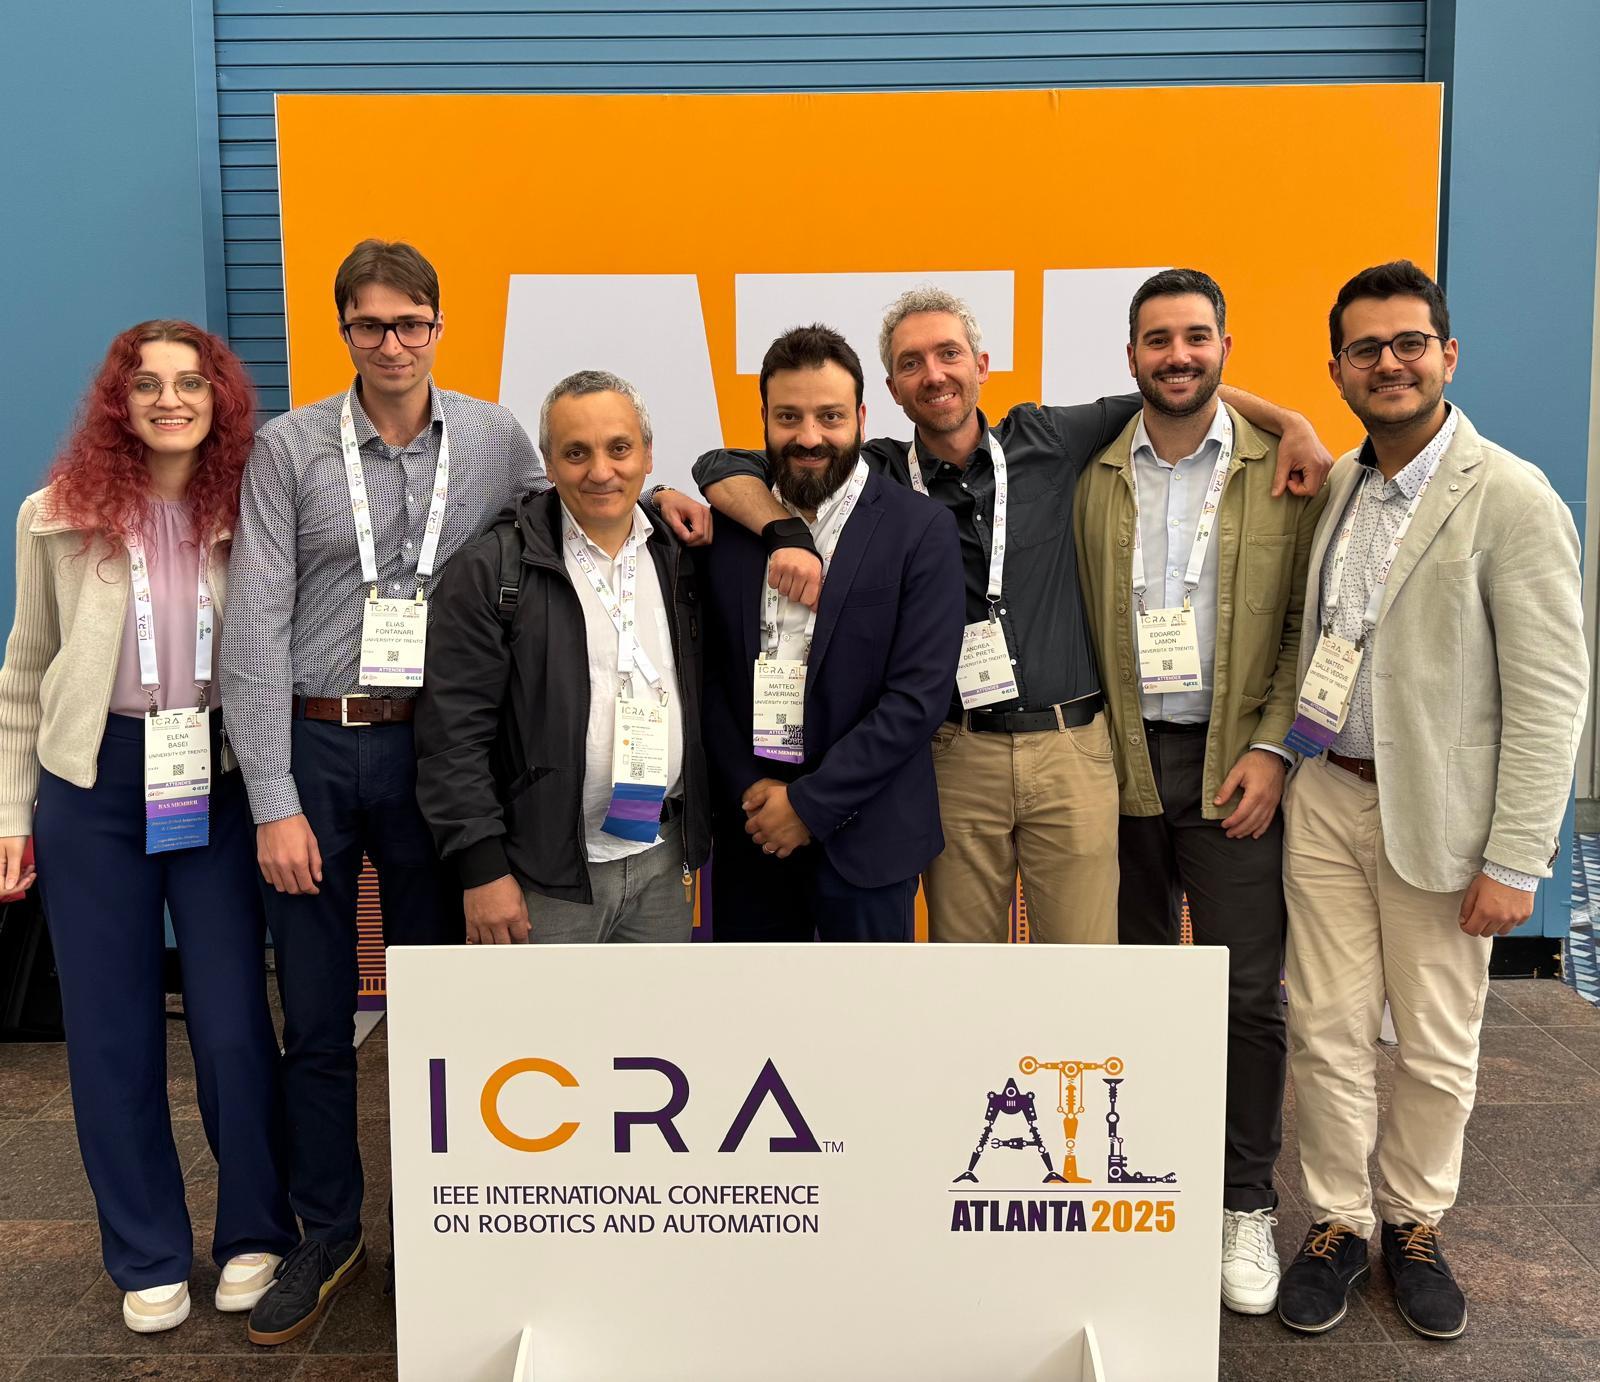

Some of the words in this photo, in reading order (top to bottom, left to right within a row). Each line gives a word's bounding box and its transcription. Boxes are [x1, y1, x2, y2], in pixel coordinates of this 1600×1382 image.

[1214, 471, 1226, 493] ICRA
[428, 510, 439, 534] ICRA
[577, 550, 593, 574] ICRA
[628, 555, 636, 579] ICRA
[371, 604, 398, 613] ICRA
[1141, 615, 1166, 624] ICRA
[139, 614, 147, 641] ICRA
[375, 628, 414, 636] FONTANARI
[1149, 630, 1181, 638] EDOARDO
[966, 642, 990, 653] ANDREA
[1322, 639, 1341, 653] ICRA
[976, 648, 995, 657] PRETE
[759, 666, 785, 674] ICRA
[1315, 662, 1330, 673] DALLE
[1325, 658, 1345, 671] MATTEO
[621, 706, 645, 716] ICRA
[151, 717, 180, 726] ICRA
[166, 733, 189, 741] ELENA
[168, 741, 189, 749] BASEI
[148, 751, 179, 760] UNIVERSITY
[187, 748, 208, 756] TRENTO
[429, 1057, 823, 1153] ICRA
[433, 1185, 479, 1205] IEEE
[486, 1185, 662, 1205] INTERNATIONAL
[668, 1185, 820, 1205] CONFERENCE
[950, 1200, 1087, 1232] ATLANTA
[1091, 1200, 1176, 1232] 2025
[433, 1214, 470, 1234] ON
[479, 1214, 596, 1234] ROBOTICS
[603, 1214, 656, 1234] AND
[663, 1214, 820, 1234] AUTOMATION
